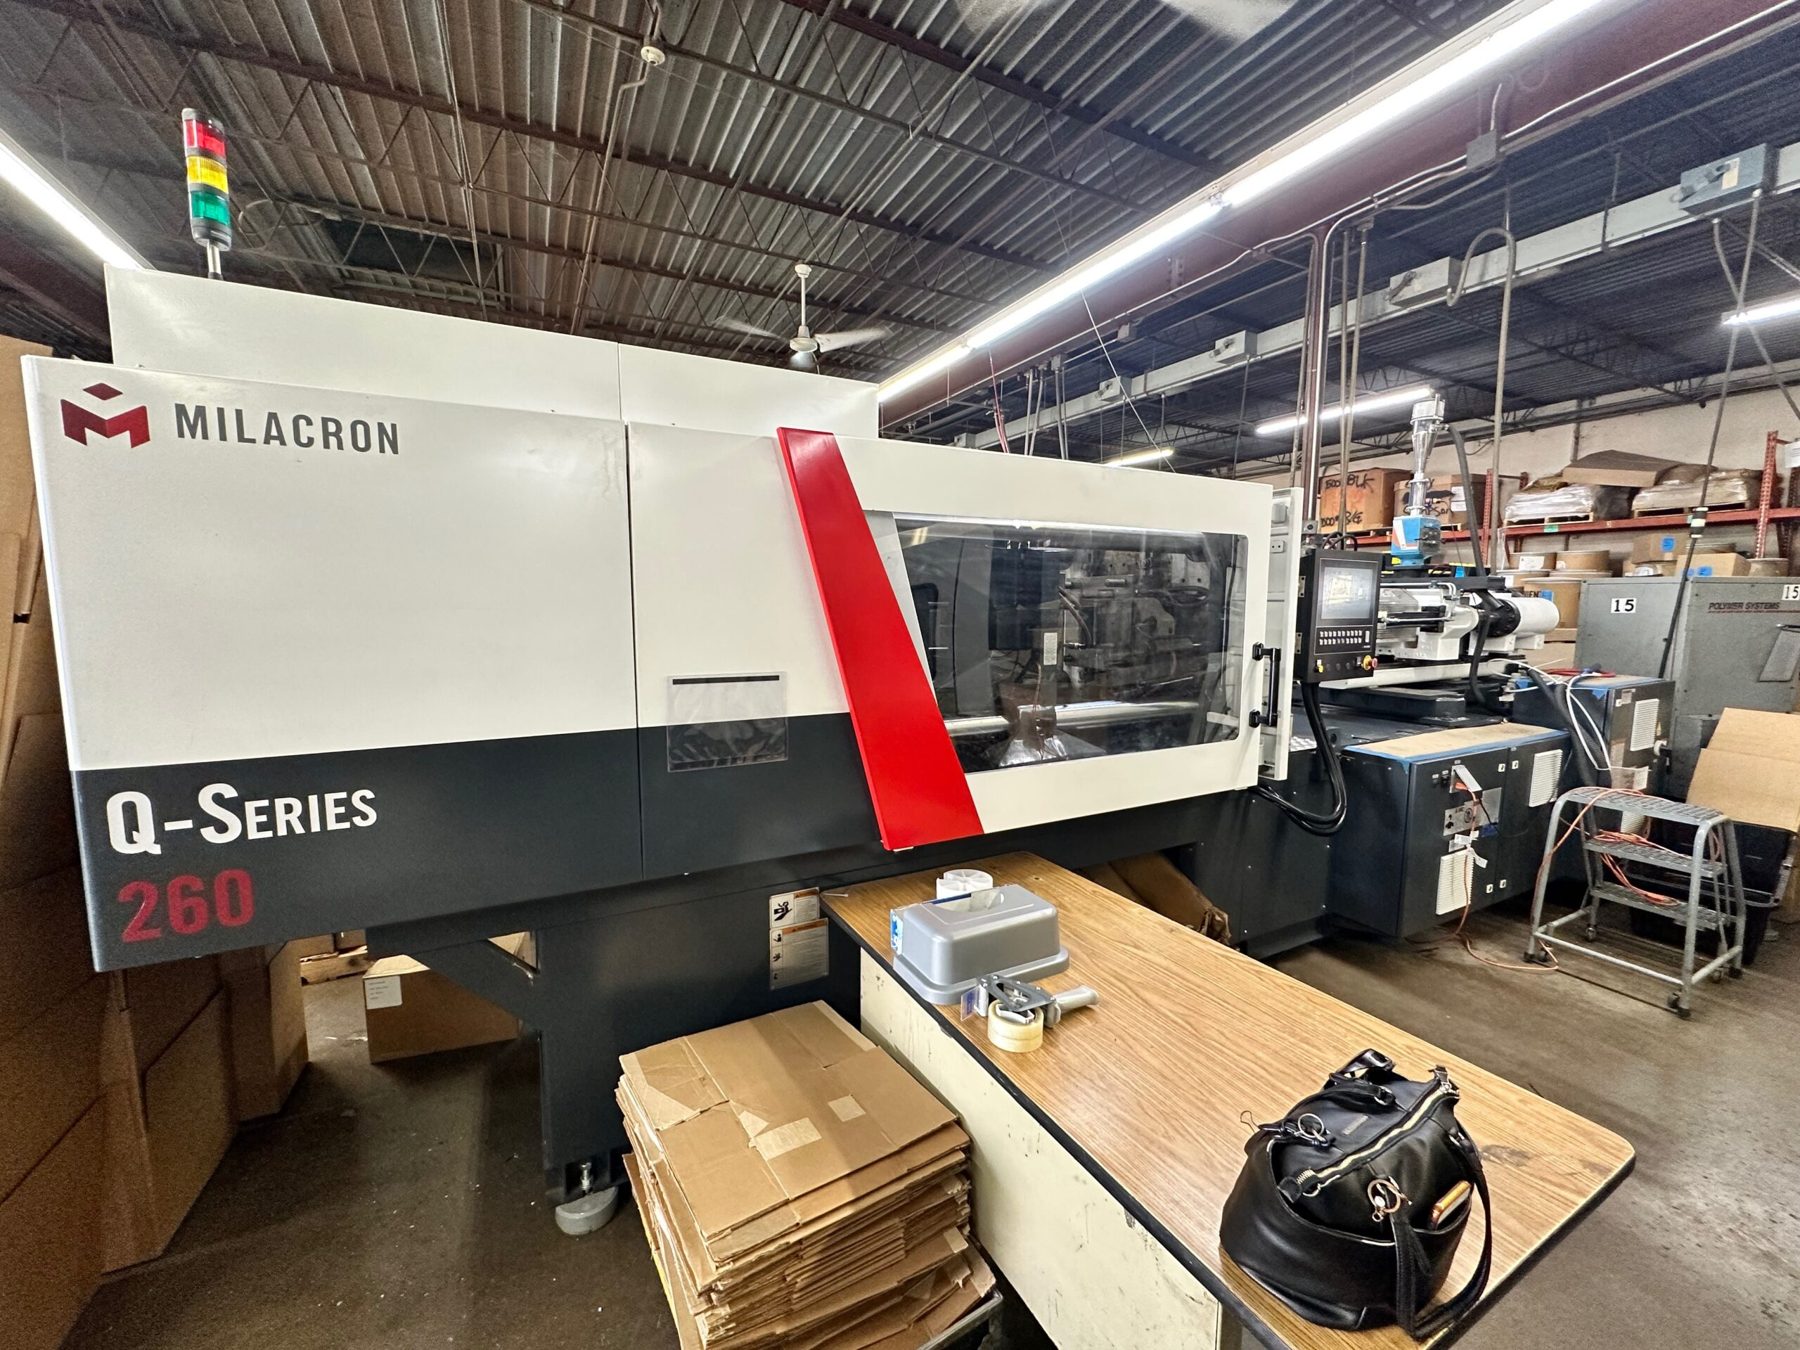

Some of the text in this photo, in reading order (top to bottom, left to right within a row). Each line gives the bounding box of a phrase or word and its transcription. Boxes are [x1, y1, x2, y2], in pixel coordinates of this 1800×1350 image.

[174, 402, 400, 455] MILACRON
[1785, 585, 1799, 599] 15
[1614, 598, 1635, 612] 15
[1708, 601, 1780, 610] POLYMER SYSTEMS
[117, 868, 255, 944] 260
